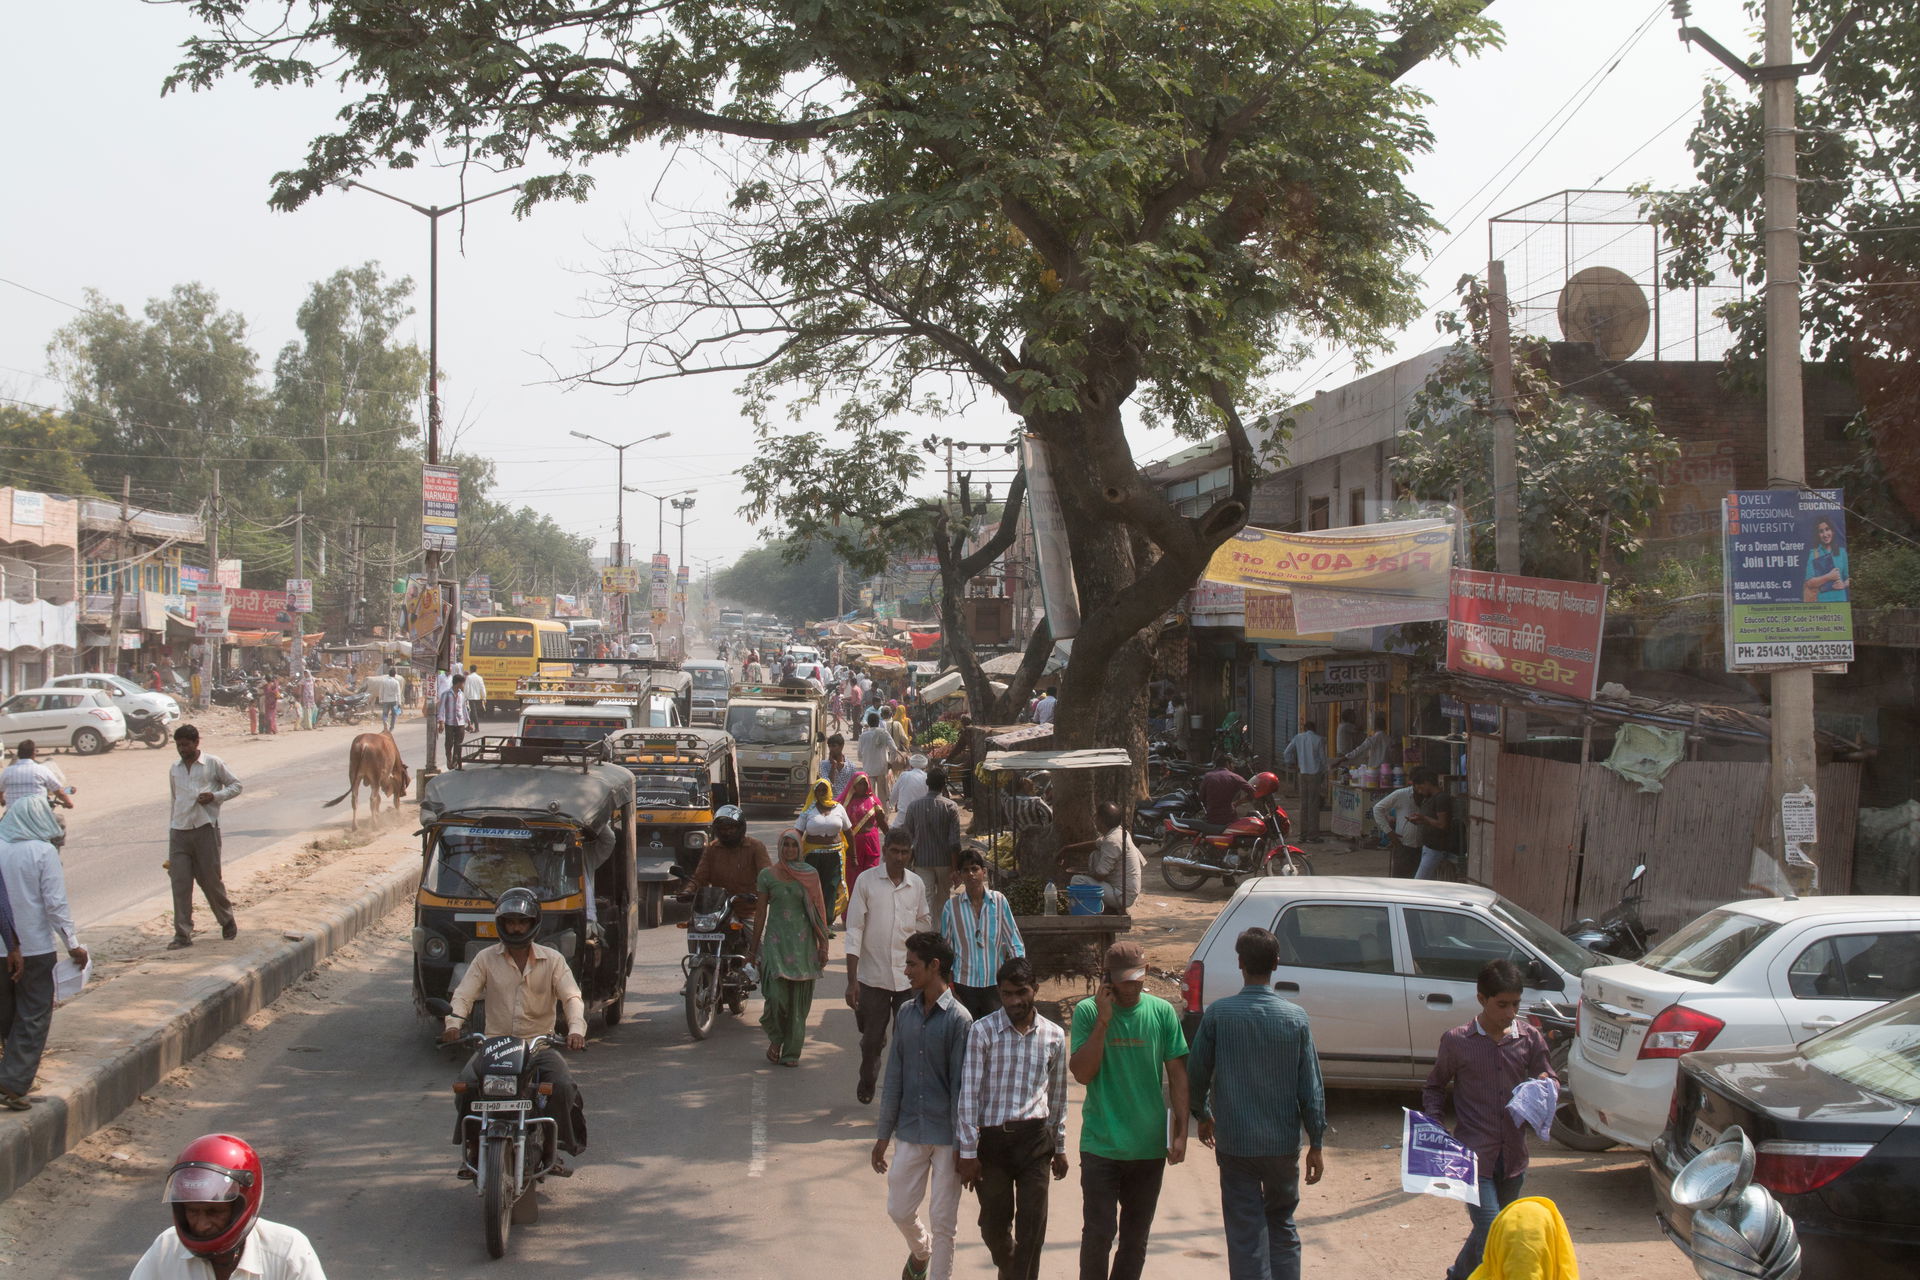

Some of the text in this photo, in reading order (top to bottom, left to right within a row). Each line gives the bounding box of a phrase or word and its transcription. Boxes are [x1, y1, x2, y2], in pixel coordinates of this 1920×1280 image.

[1800, 491, 1836, 500] DISTANCE
[1799, 502, 1841, 511] EDUCATION
[1735, 540, 1805, 552] For a Dream Career
[1742, 555, 1800, 568] Join LPU-DE
[1512, 623, 1546, 653] समिति
[1738, 644, 1852, 658] PH: 251431, 9034335021
[1460, 649, 1579, 686] जल कुटीर
[469, 827, 504, 835] DEWAN
[484, 1037, 513, 1057] Mohit
